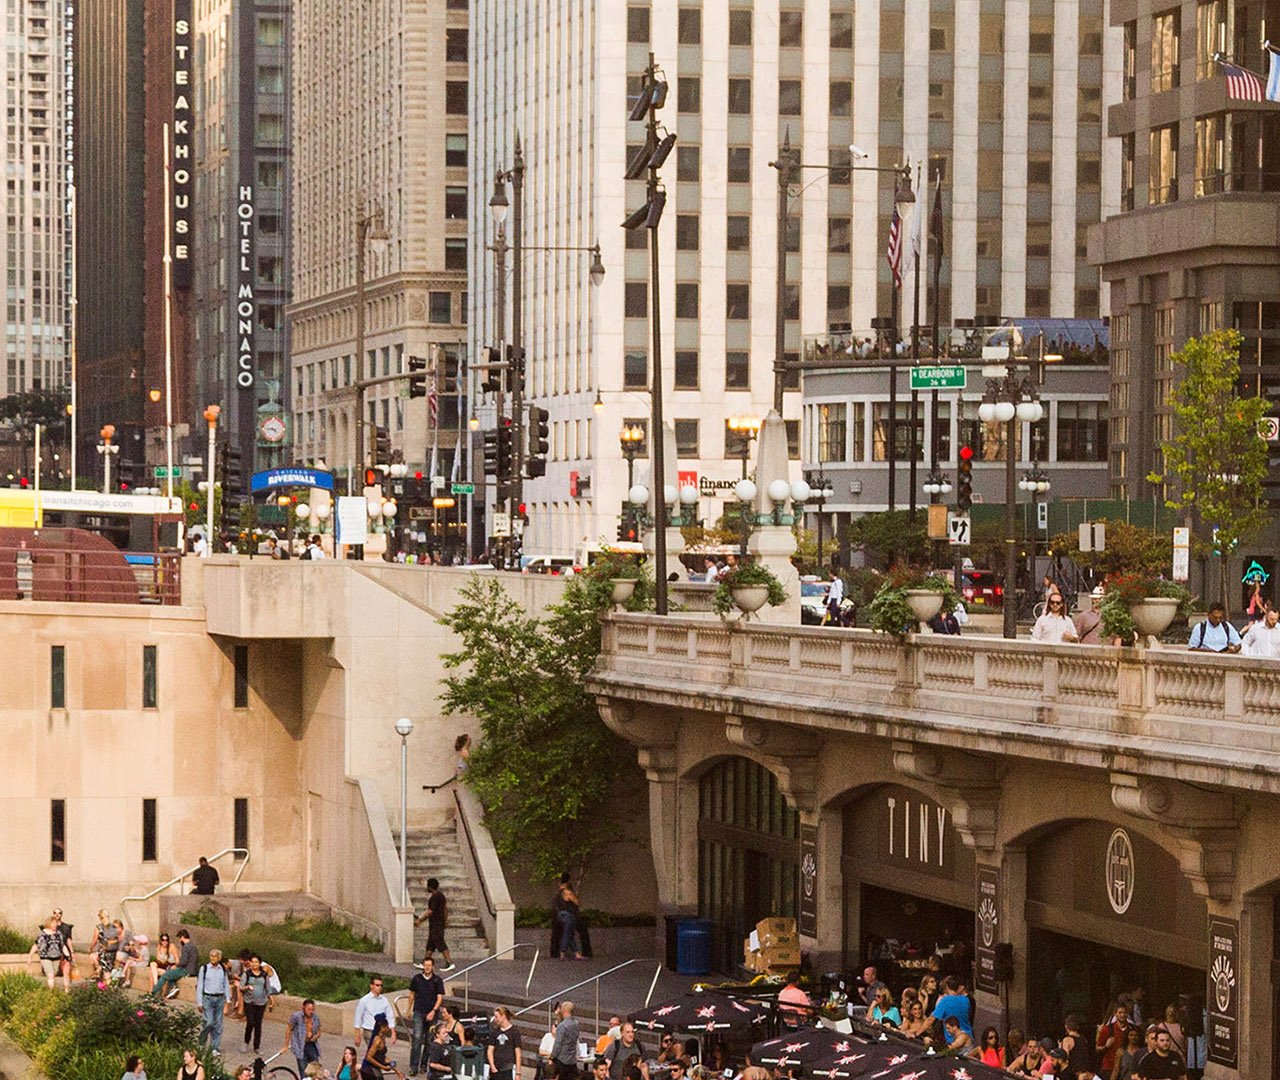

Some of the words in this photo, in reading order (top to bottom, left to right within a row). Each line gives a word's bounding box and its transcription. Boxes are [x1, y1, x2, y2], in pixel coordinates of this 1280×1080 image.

[174, 20, 190, 260] STEAKHOUSE
[238, 186, 254, 272] HOTEL
[238, 283, 254, 388] MONACO
[918, 368, 955, 379] DEARBORN
[268, 474, 317, 485] RIVERWALK
[888, 797, 946, 867] TINY
